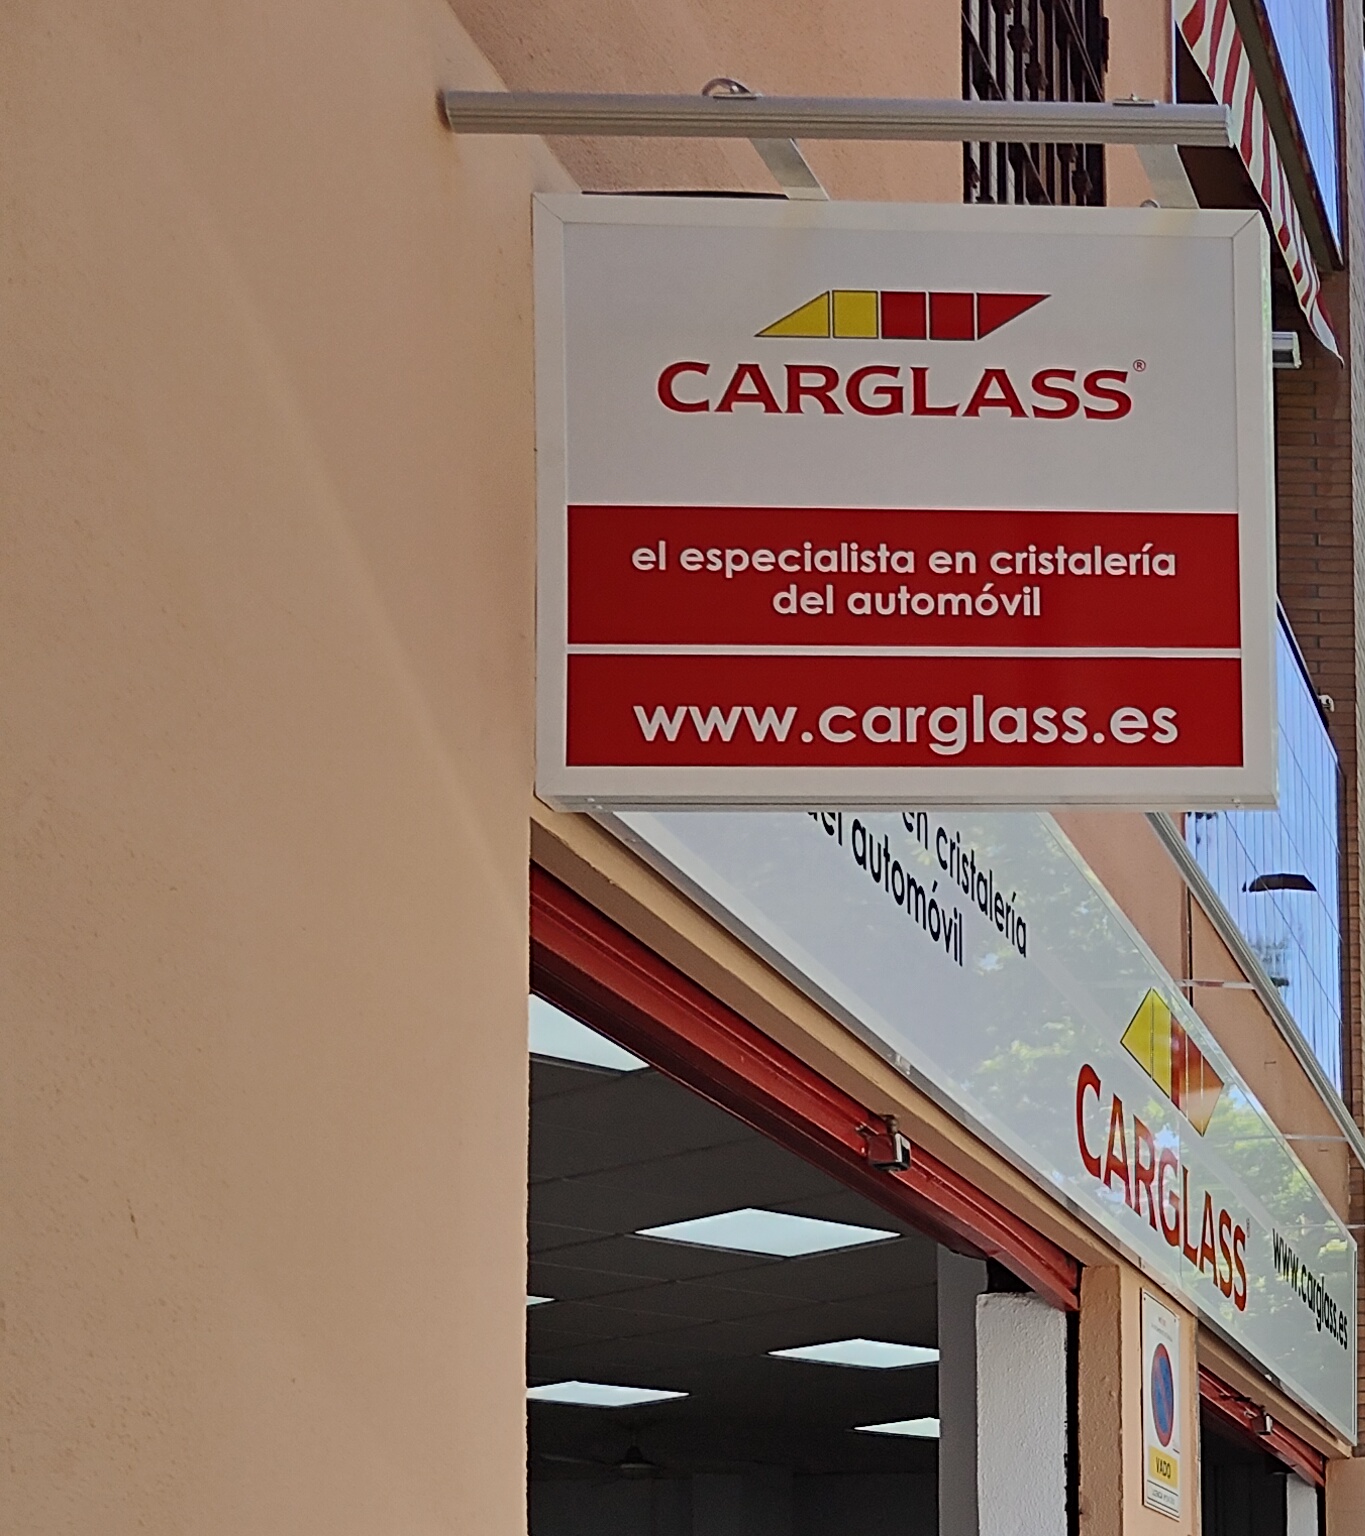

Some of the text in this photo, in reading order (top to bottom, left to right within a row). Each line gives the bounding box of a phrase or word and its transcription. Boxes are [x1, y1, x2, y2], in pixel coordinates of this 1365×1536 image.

[631, 540, 1177, 578] el especialista en cristalería
[772, 583, 1042, 617] del automóvil
[633, 694, 1179, 756] www.carglass.es
[851, 818, 963, 967] automóvil
[936, 826, 1027, 958] cristalería
[1076, 1063, 1247, 1312] CARGLASS
[1272, 1228, 1348, 1350] www.carglass.es
[1156, 1456, 1171, 1479] VADO
